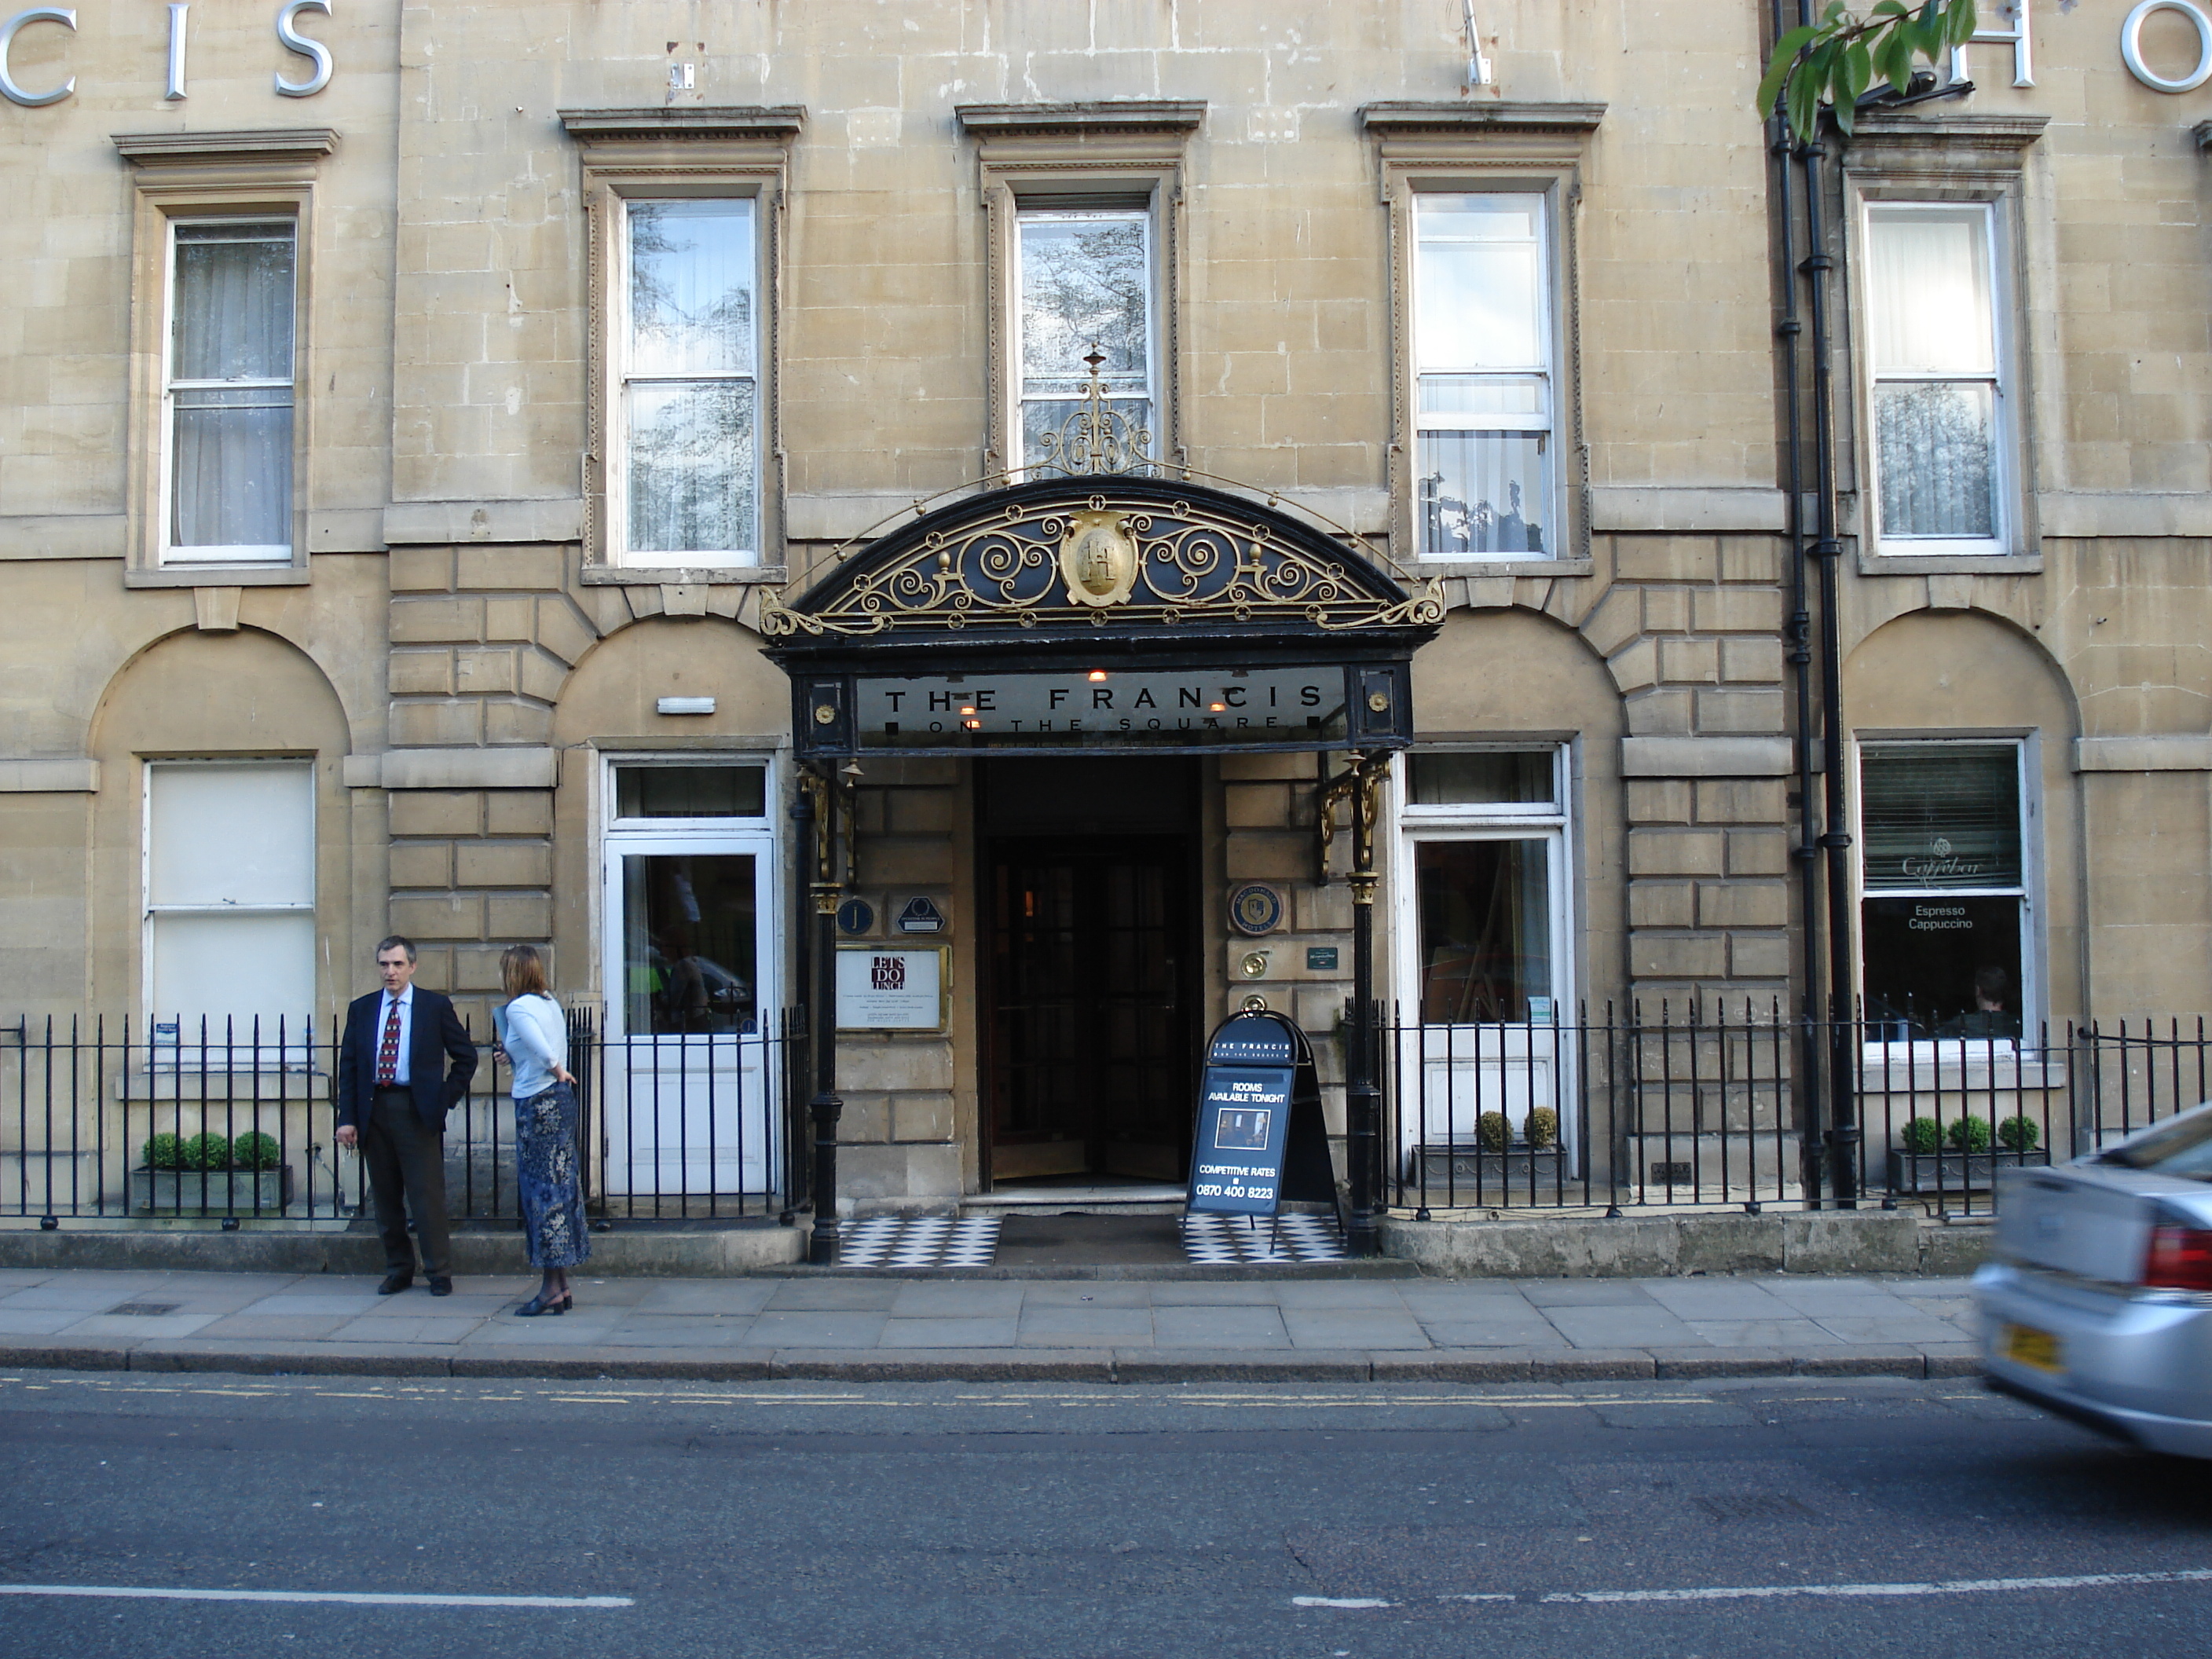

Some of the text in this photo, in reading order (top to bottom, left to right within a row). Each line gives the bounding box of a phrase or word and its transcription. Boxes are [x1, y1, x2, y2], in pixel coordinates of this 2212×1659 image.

[885, 686, 1320, 712] THE FRANCIS
[929, 716, 1277, 733] ON THE SQUARE
[1915, 905, 1965, 917] Espresso
[1908, 918, 1973, 931] Cappuccino
[871, 956, 905, 969] LET'S
[877, 969, 901, 982] DO
[1232, 1082, 1263, 1093] ROOMS
[1208, 1092, 1285, 1104] AVAILABLE TONIGHT
[1199, 1165, 1276, 1177] COMPETITIVE RATES
[1196, 1185, 1273, 1199] 0870 400 8223
